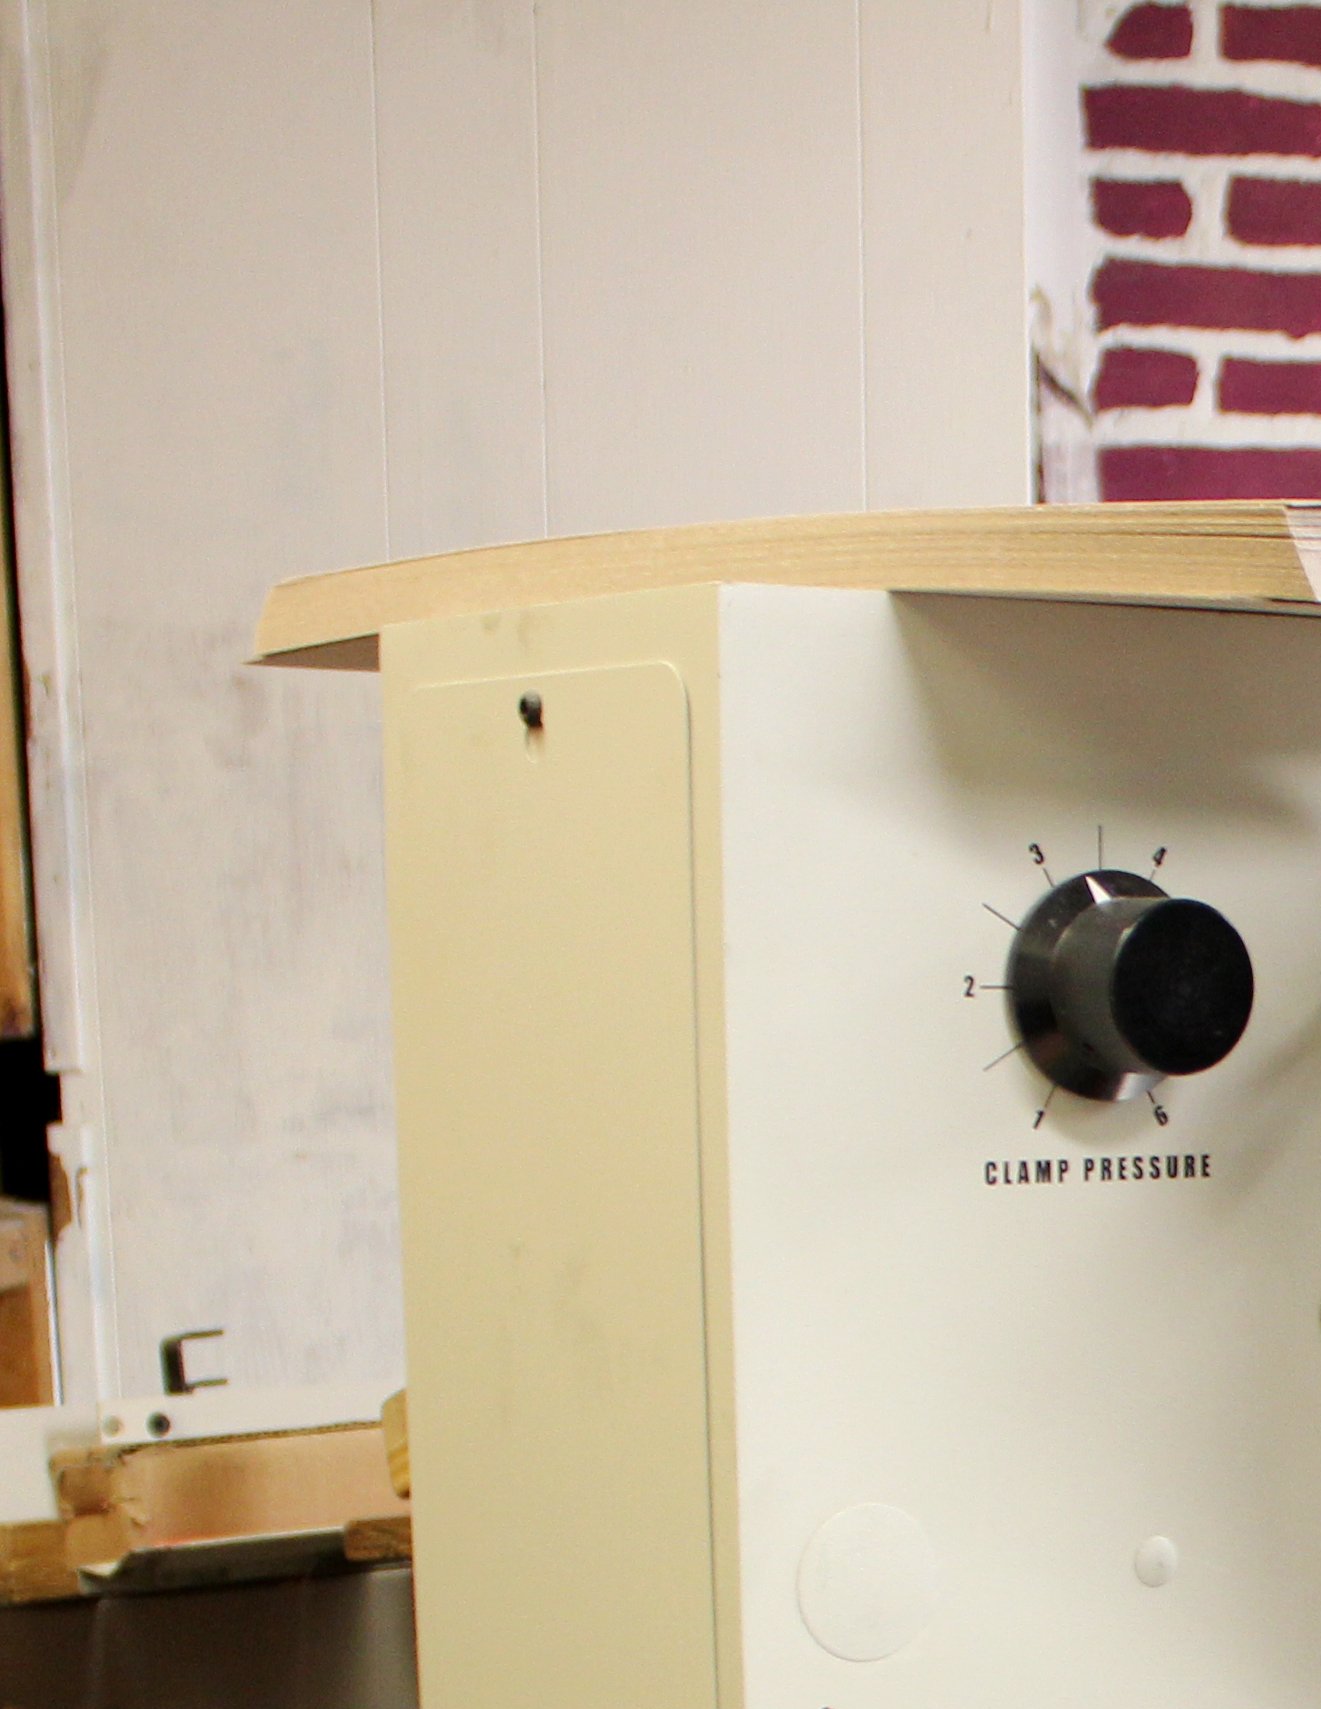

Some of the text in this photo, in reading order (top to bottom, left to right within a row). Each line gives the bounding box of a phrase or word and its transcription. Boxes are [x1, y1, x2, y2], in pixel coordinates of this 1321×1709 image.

[1029, 843, 1045, 865] 3
[1153, 847, 1167, 867] 4
[963, 975, 975, 998] 2
[1154, 1105, 1168, 1127] 6
[984, 1154, 1211, 1186] CLAMP PRESSURE
